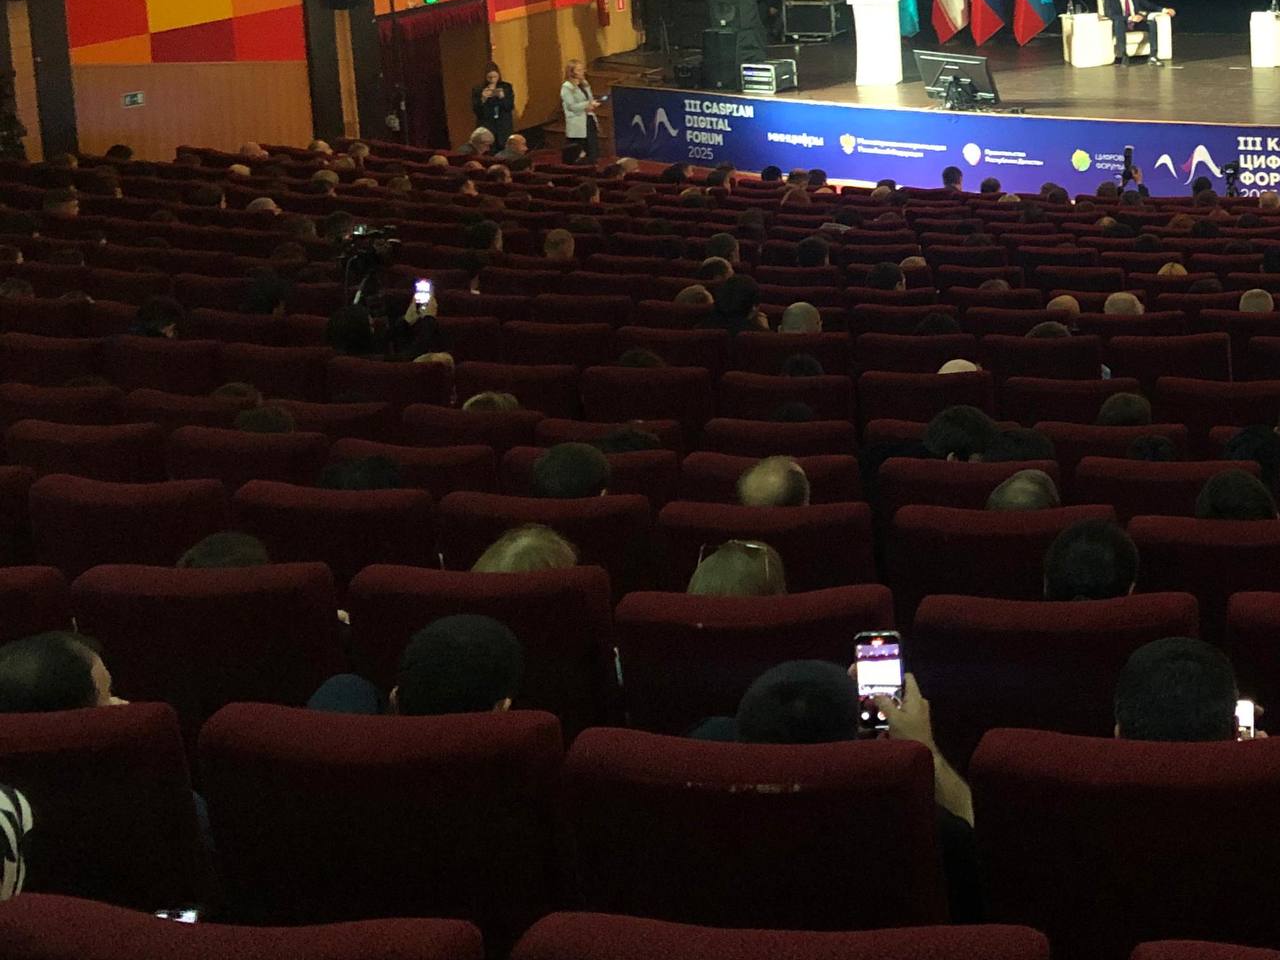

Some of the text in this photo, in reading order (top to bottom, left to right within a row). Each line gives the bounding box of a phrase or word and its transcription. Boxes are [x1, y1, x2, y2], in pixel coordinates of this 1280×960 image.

[702, 102, 755, 119] CASPIAN
[684, 115, 732, 132] DIGITAL
[686, 131, 724, 146] FORUM
[688, 146, 714, 160] 2025
